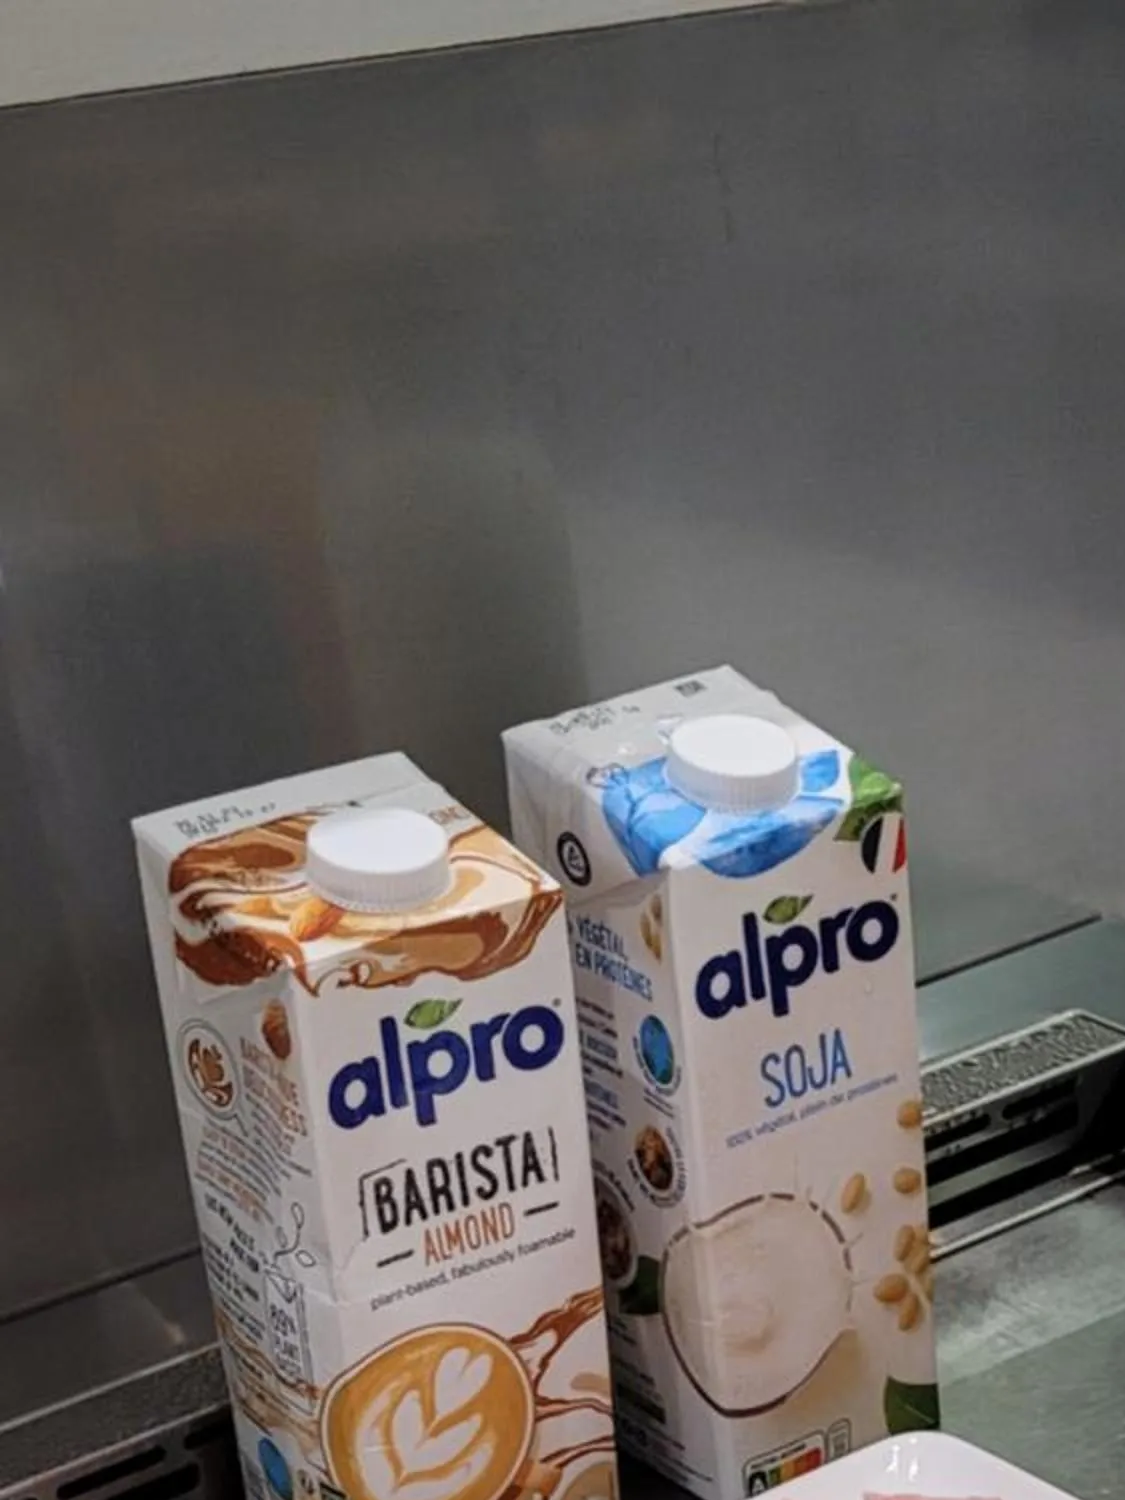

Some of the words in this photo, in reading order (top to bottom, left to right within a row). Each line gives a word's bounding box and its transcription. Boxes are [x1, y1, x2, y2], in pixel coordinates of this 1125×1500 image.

[694, 899, 899, 1020] alpro
[327, 1004, 565, 1130] alpro
[761, 1027, 852, 1108] SOJA
[373, 1131, 546, 1235] BARISTA
[422, 1202, 516, 1267] ALMOND
[451, 1250, 516, 1280] fabulously
[518, 1227, 576, 1257] foamable
